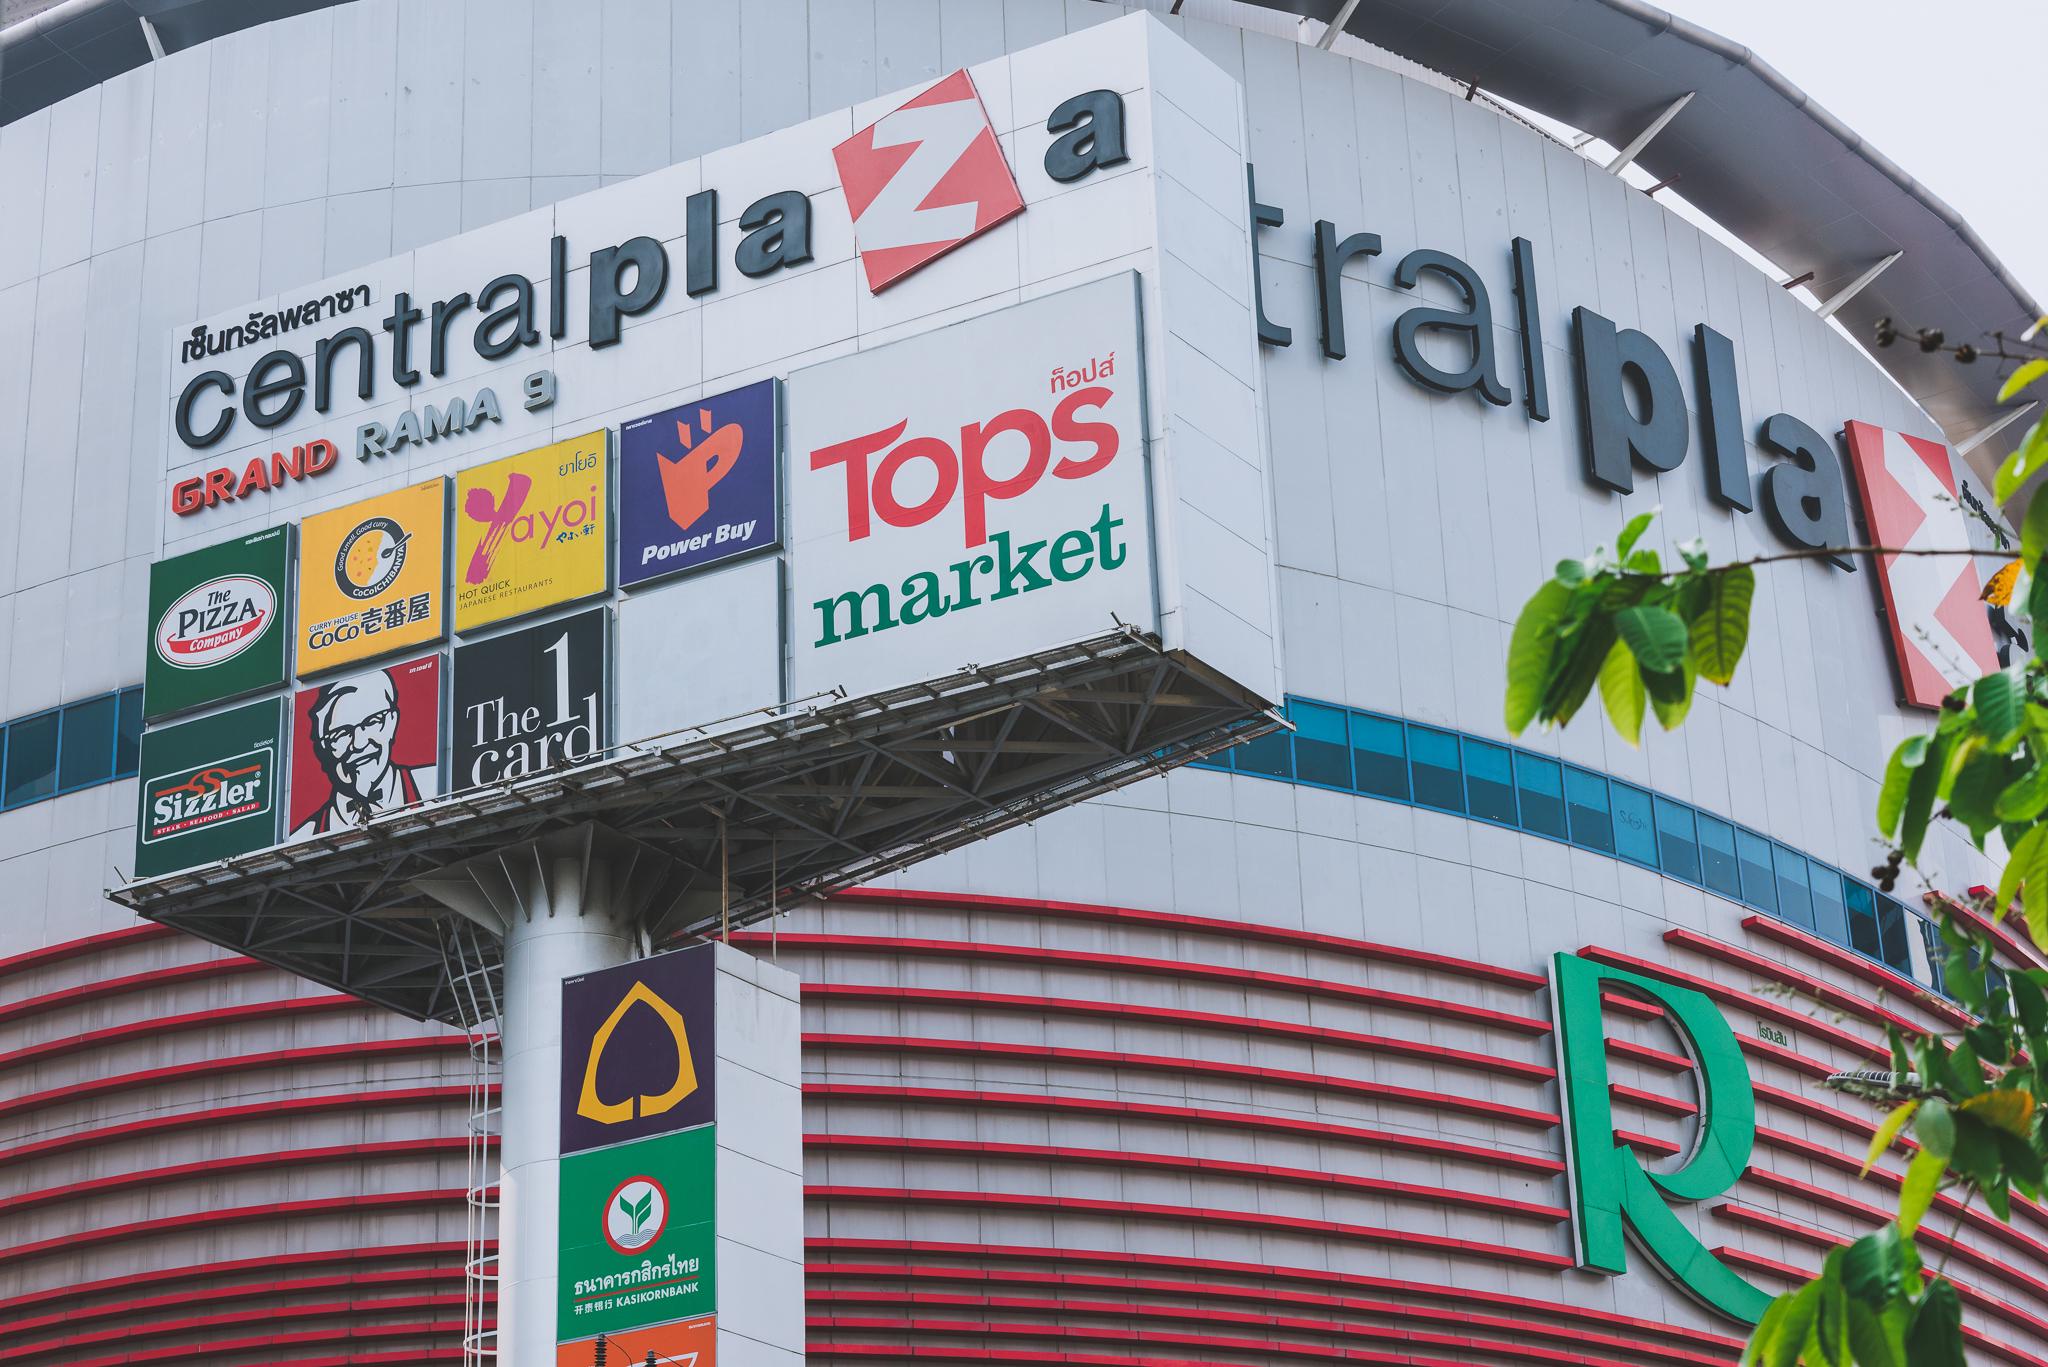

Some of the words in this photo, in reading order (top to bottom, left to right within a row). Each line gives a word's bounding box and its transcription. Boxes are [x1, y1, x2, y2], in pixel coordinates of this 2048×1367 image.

[181, 284, 370, 364] เซ็นทรัลพลาซา
[1049, 351, 1116, 395] ท็อปส์
[172, 438, 339, 516] GRAND
[356, 386, 502, 461] RAMA
[523, 369, 555, 410] 9
[559, 450, 598, 477] ยาโยอิ
[464, 472, 598, 585] Yayoi
[641, 531, 712, 566] Power
[714, 518, 758, 549] Buy
[458, 588, 478, 601] HOT
[480, 578, 512, 595] QUICK
[459, 594, 497, 611] JAPANESE
[499, 577, 554, 599] RESTAURANTS
[812, 503, 1128, 649] market
[177, 597, 258, 640] PIZZA
[207, 589, 232, 607] The
[189, 626, 244, 652] Company
[308, 619, 333, 633] CURRY
[333, 612, 359, 626] HOUSE
[466, 695, 541, 748] The
[543, 631, 581, 728] 1
[471, 691, 602, 790] card
[153, 778, 261, 826] Sizzler
[156, 823, 181, 835] STEAK
[189, 812, 223, 826] SEAFOOD
[231, 803, 256, 815] SALAD
[573, 1253, 700, 1296] ธนาคารกสิกรไทย
[616, 1281, 700, 1308] KASIKORNBANK
